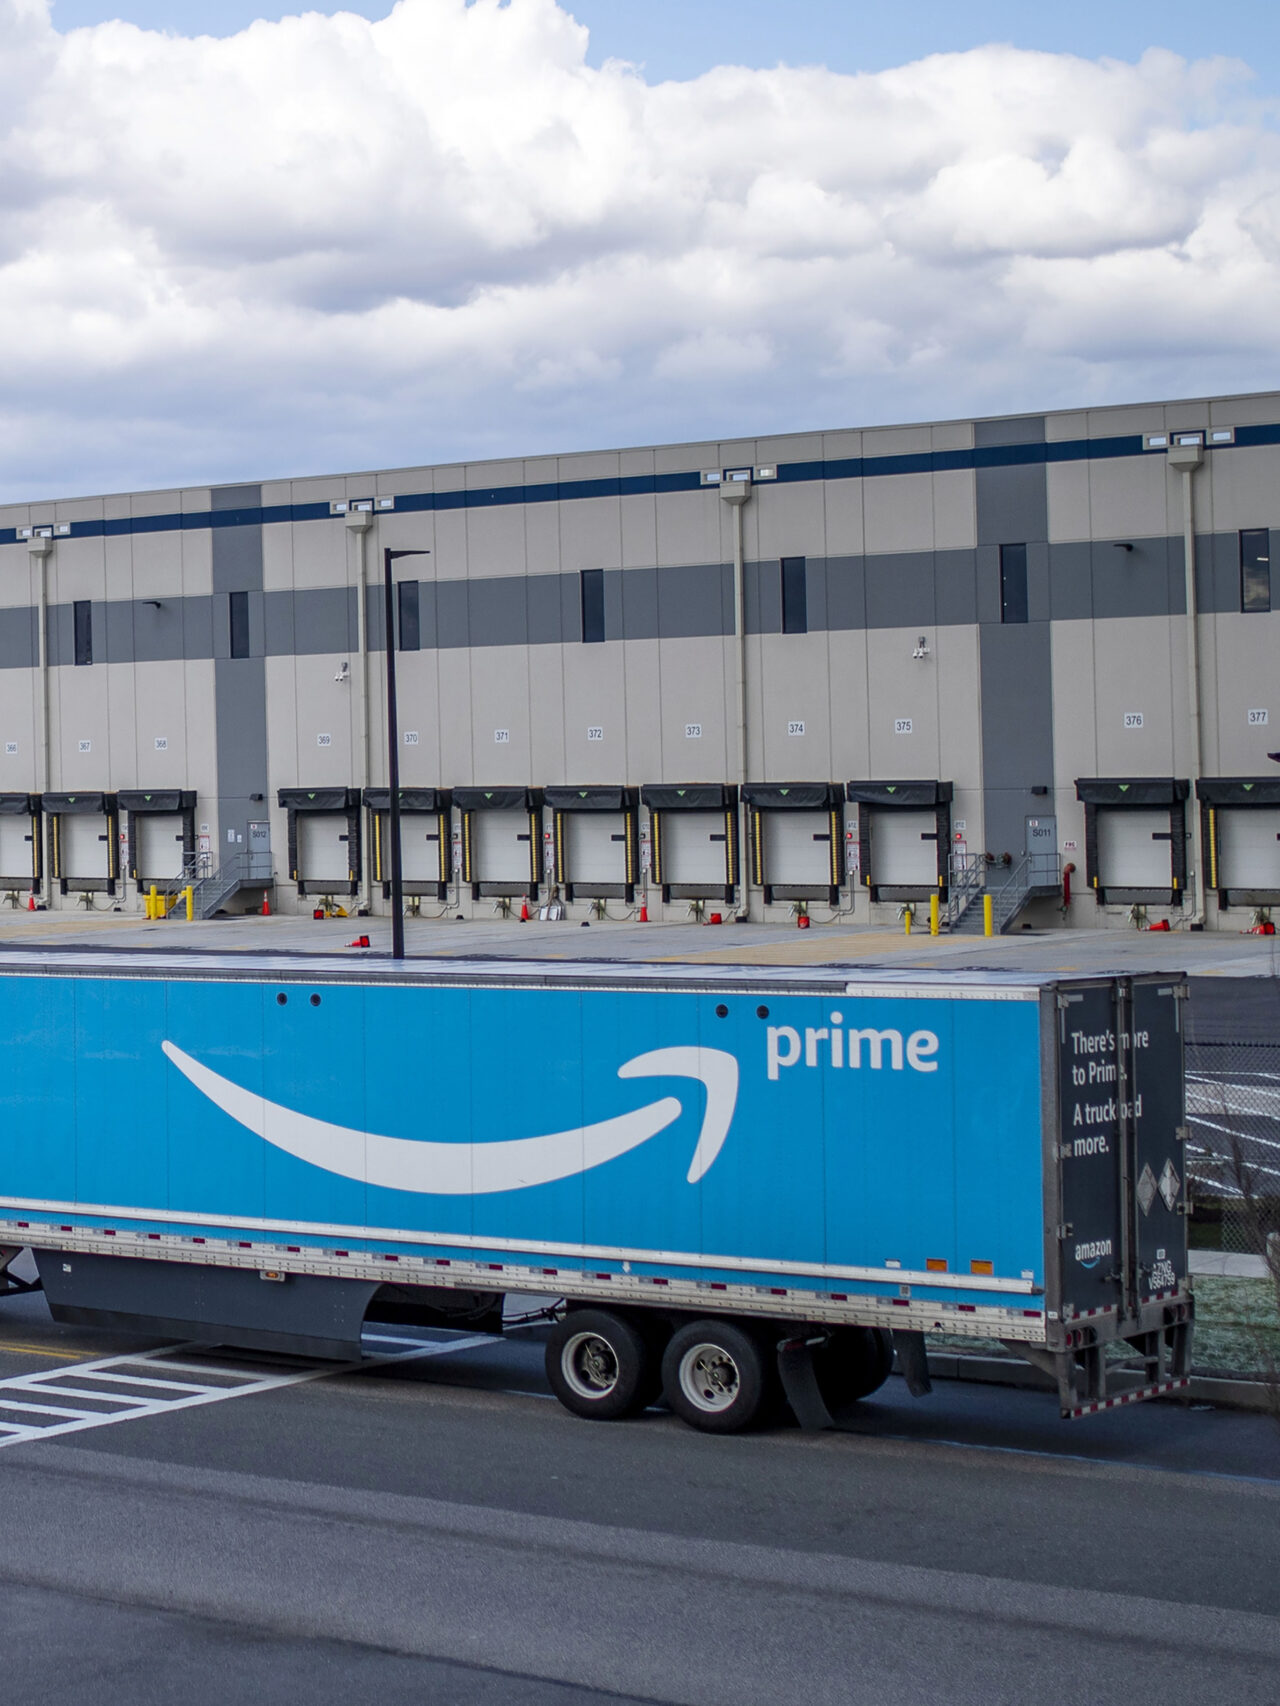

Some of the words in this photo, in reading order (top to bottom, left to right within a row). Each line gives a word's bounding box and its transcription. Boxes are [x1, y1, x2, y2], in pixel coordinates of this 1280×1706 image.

[1125, 715, 1142, 725] 376
[1249, 711, 1266, 722] 377
[686, 726, 701, 735] 373
[789, 723, 804, 733] 374
[896, 721, 912, 731] 375
[405, 733, 418, 742] 370
[495, 732, 508, 741] 371
[588, 729, 602, 738] 372
[318, 735, 330, 744] 369
[1032, 828, 1051, 837] S011
[767, 1011, 939, 1080] prime
[1071, 1029, 1115, 1055] There's
[1072, 1064, 1086, 1086] to
[1073, 1103, 1083, 1126] A
[1085, 1094, 1142, 1124] truckoad
[1074, 1135, 1109, 1157] more.
[1075, 1239, 1112, 1262] amazon
